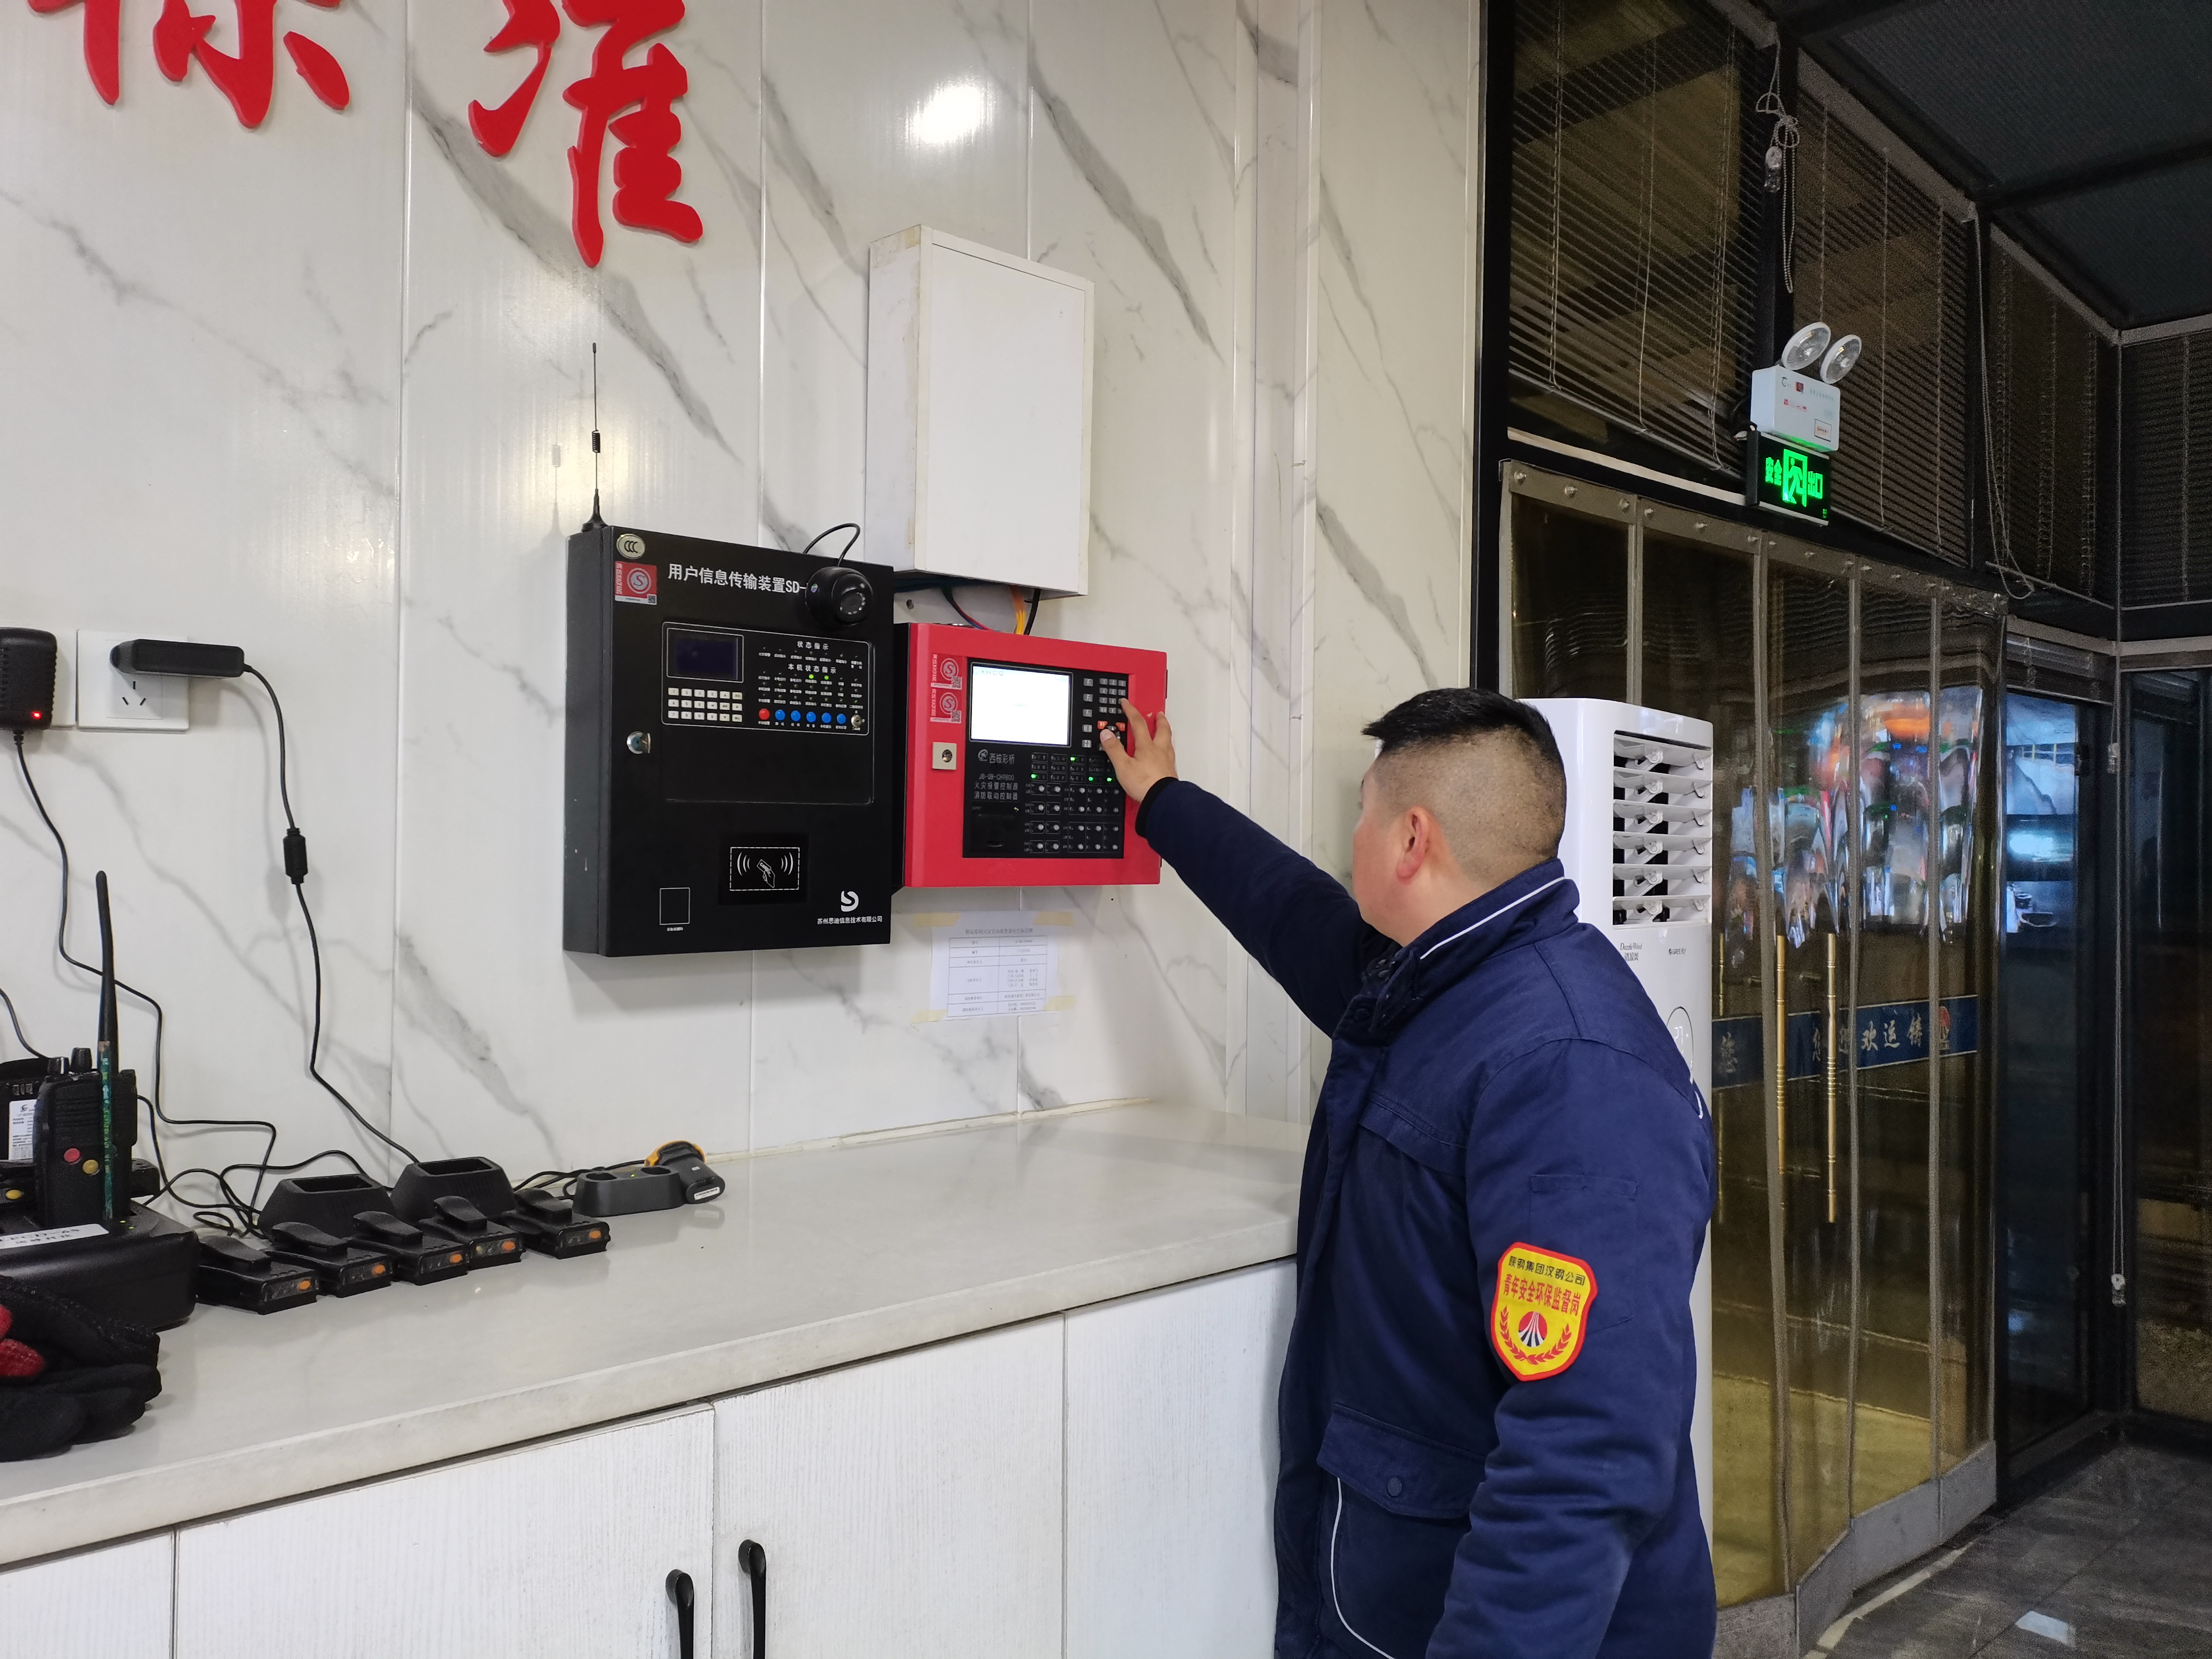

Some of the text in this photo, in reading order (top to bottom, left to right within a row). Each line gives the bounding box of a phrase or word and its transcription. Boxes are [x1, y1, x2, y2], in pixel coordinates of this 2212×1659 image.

[1766, 457, 1823, 500] 安全 出口
[797, 640, 829, 650] 状态指示
[787, 663, 837, 674] 本机状态指示
[974, 781, 1018, 791] 火灾报警控制器
[974, 791, 1018, 801] 消防联动控制器
[817, 915, 883, 925] 苏州思迪信息技术有限公司
[1508, 1255, 1587, 1286] 陕钢集团汉钢公司
[1503, 1274, 1582, 1317] 青年安全环保监督岗
